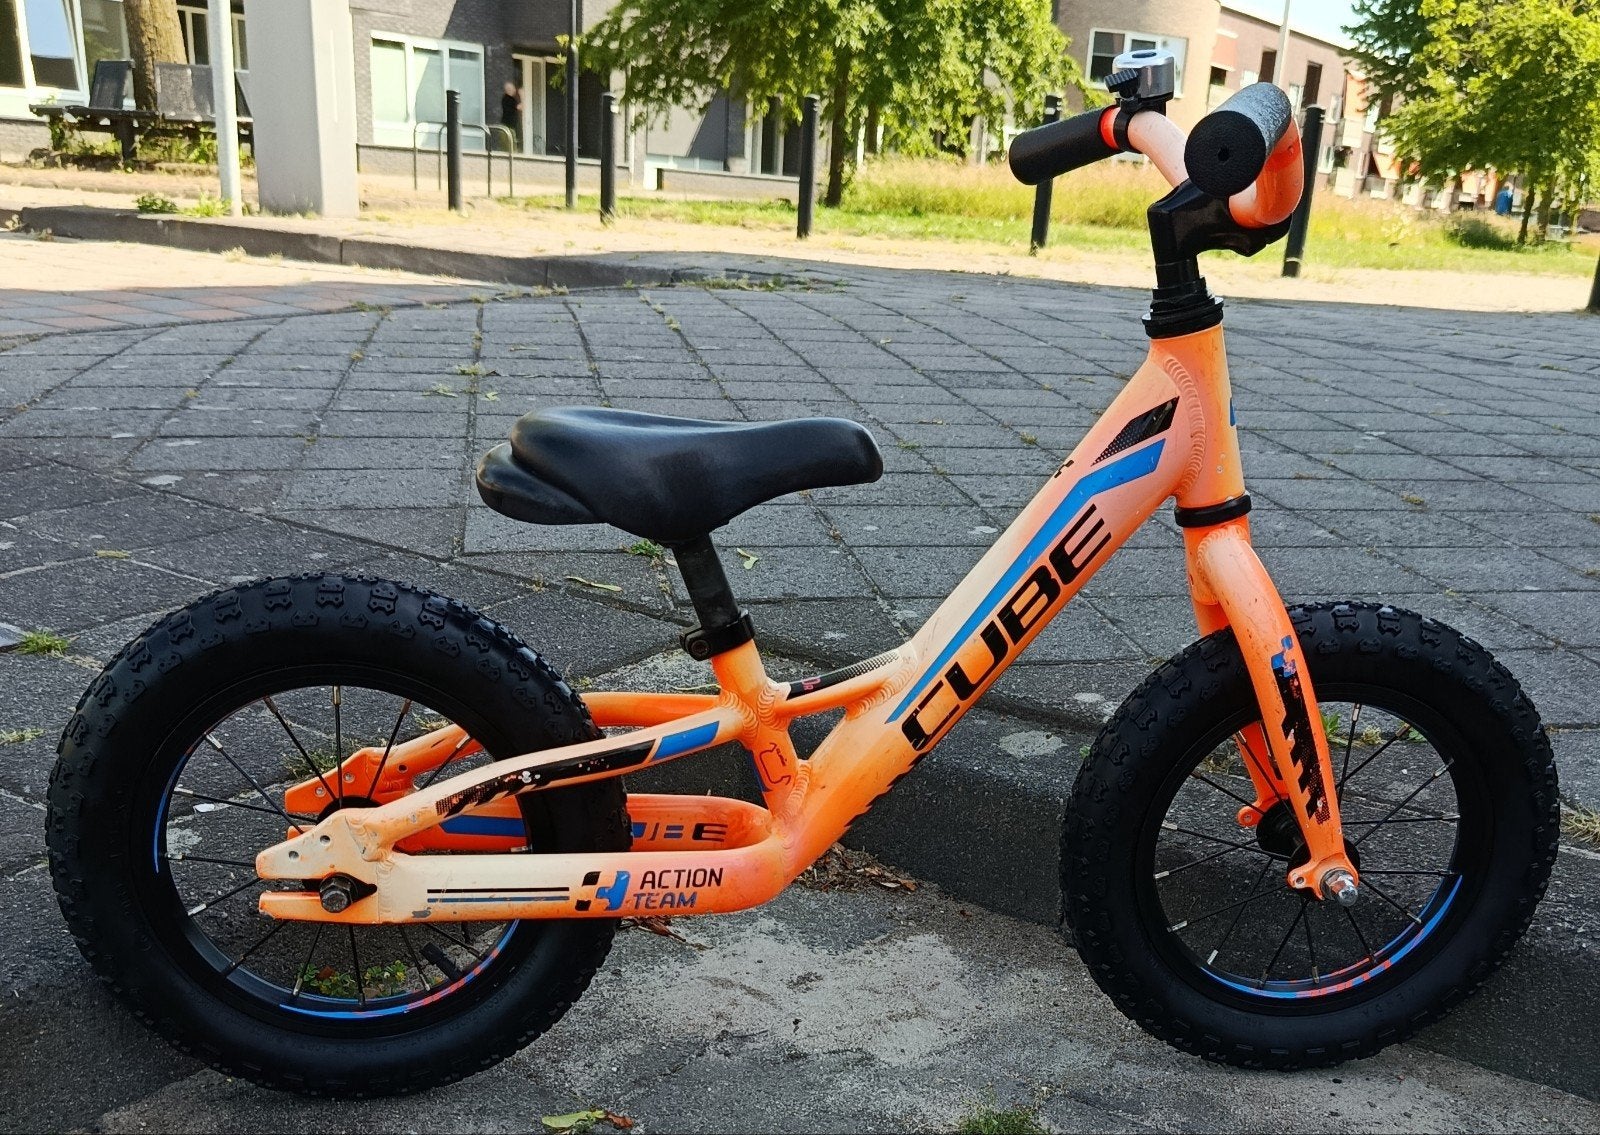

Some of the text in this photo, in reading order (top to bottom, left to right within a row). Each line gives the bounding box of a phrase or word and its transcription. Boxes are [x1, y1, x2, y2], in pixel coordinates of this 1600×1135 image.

[902, 503, 1112, 751] CUBE
[640, 867, 724, 890] ACTION
[633, 891, 698, 910] TEAM
